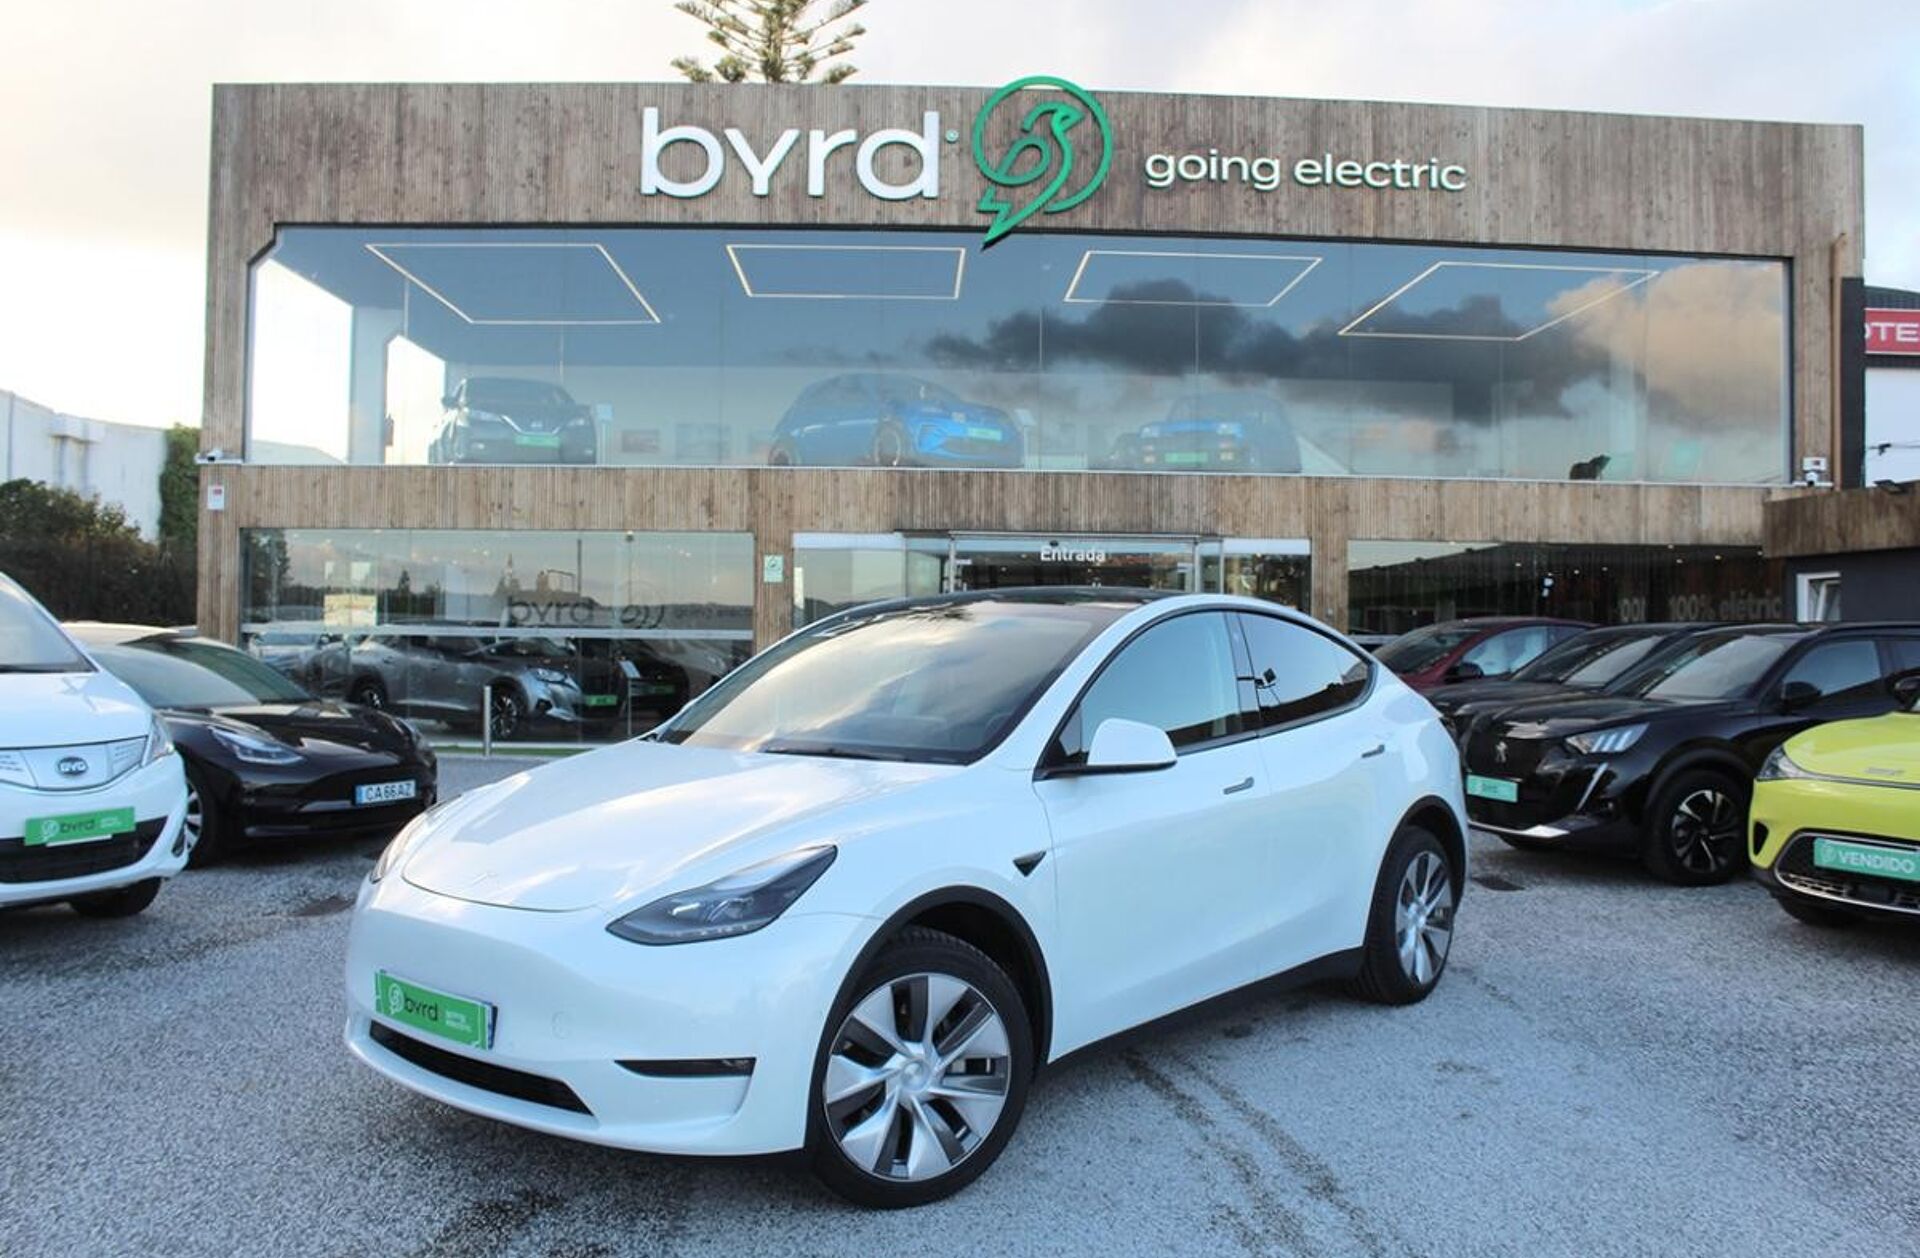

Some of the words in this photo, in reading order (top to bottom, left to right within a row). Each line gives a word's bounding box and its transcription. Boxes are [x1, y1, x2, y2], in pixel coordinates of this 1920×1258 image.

[1145, 148, 1280, 191] going
[1294, 153, 1467, 190] electric
[1040, 545, 1106, 562] Entrada
[1838, 850, 1916, 874] VENDIDO
[404, 994, 438, 1021] byrd
